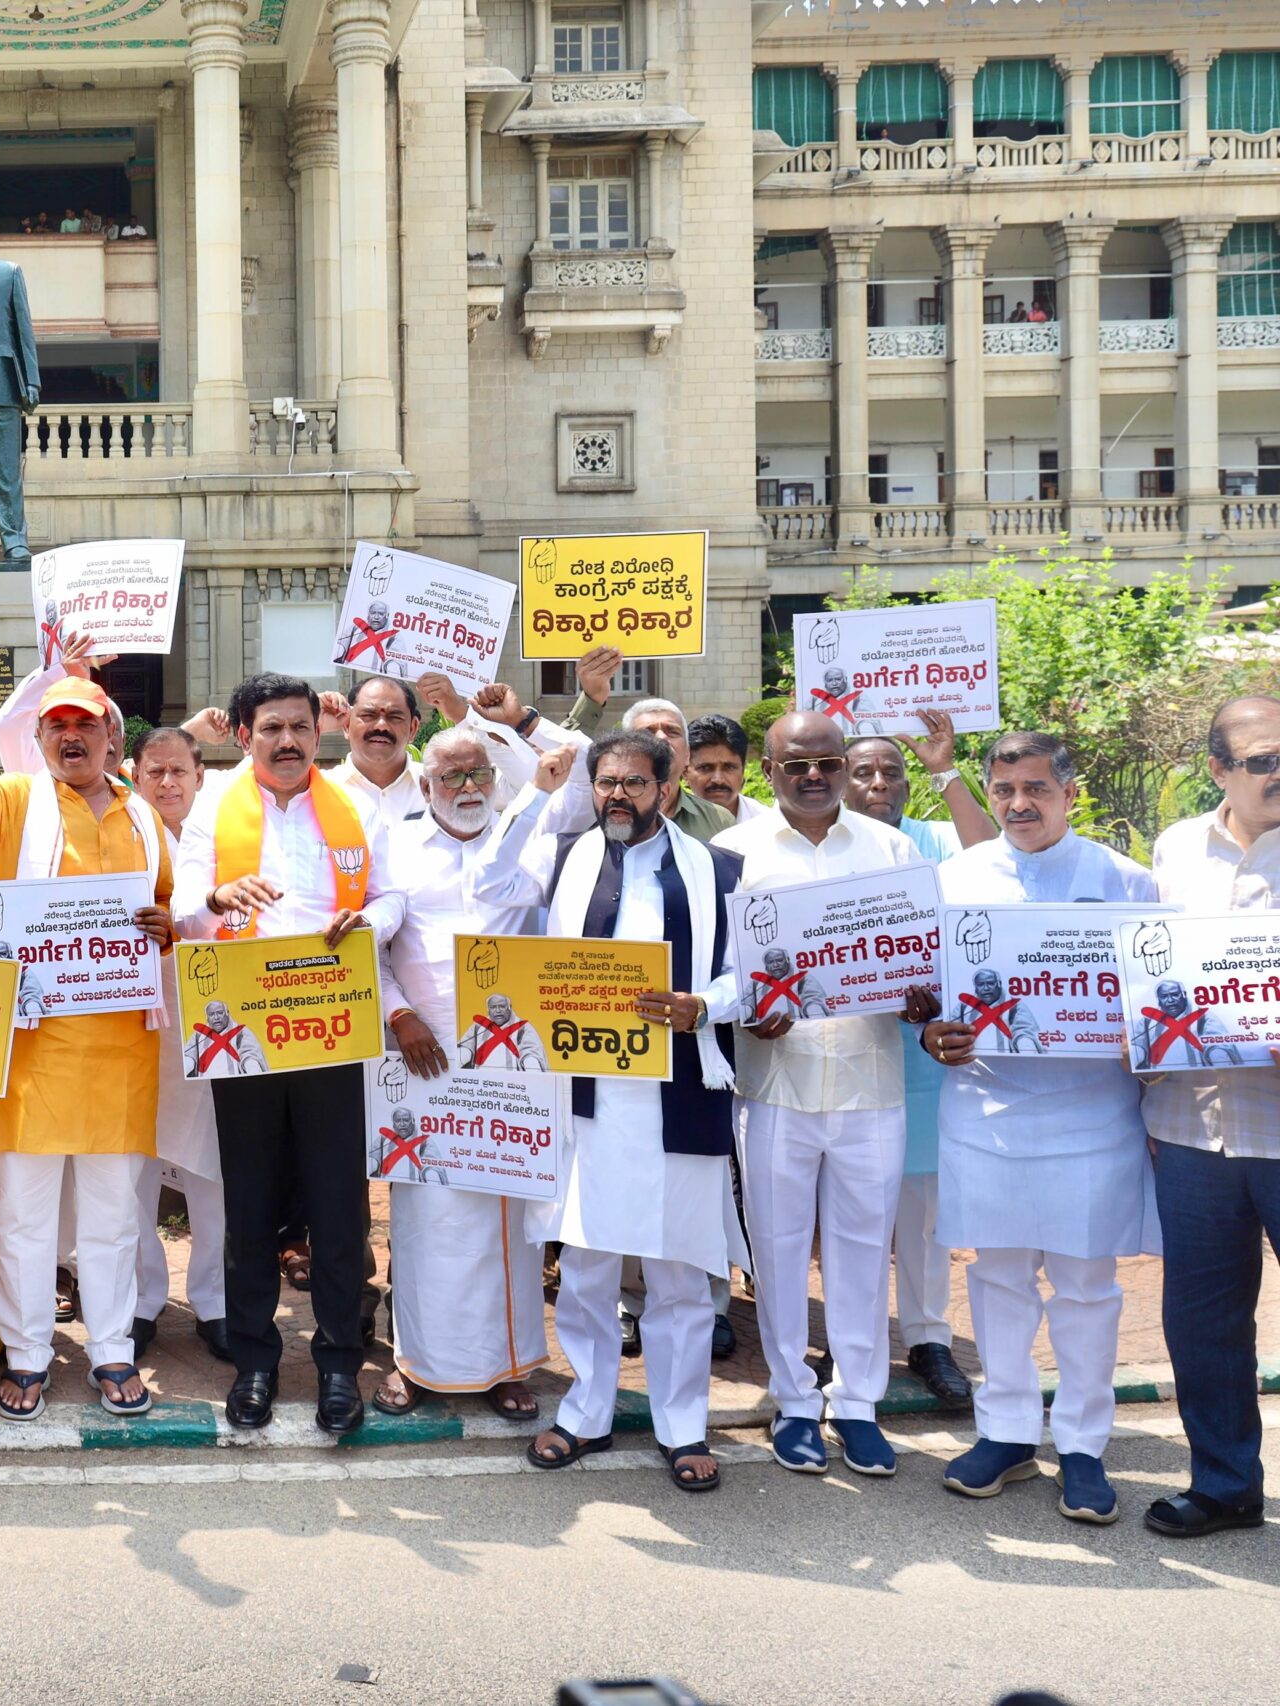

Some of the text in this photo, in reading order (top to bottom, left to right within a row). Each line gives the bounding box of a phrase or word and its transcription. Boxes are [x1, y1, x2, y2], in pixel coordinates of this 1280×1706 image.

[570, 557, 673, 575] ದೇಶ ವಿರೋಧಿ
[554, 574, 692, 601] ಕಾಂಗ್ರೆಸ್ ಪಕ್ಷಕ್ಕೆ
[392, 611, 497, 661] ಖರ್ಗೆಗೆ ಧಿಕ್ಕಾರ
[532, 605, 692, 642] ಧಿಕ್ಕಾರ ಧಿಕ್ಕಾರ
[852, 659, 987, 690] ಖರ್ಗೆಗೆ ಧಿಕ್ಕಾರ
[88, 932, 148, 966] ಧಿಕ್ಕಾರ
[795, 936, 868, 969] ಖರ್ಗೆಗೆ
[240, 998, 266, 1011] ಎಂದ
[338, 987, 372, 1002] ಖರ್ಗೆಗೆ
[1008, 970, 1088, 996] ಖರ್ಗೆಗೆ
[265, 1008, 351, 1050] ಧಿಕ್ಕಾರ
[551, 1018, 650, 1070] ಧಿಕ್ಕಾರ
[420, 1112, 551, 1156] ಖರ್ಗೆಗೆ ಧಿಕ್ಕಾರ
